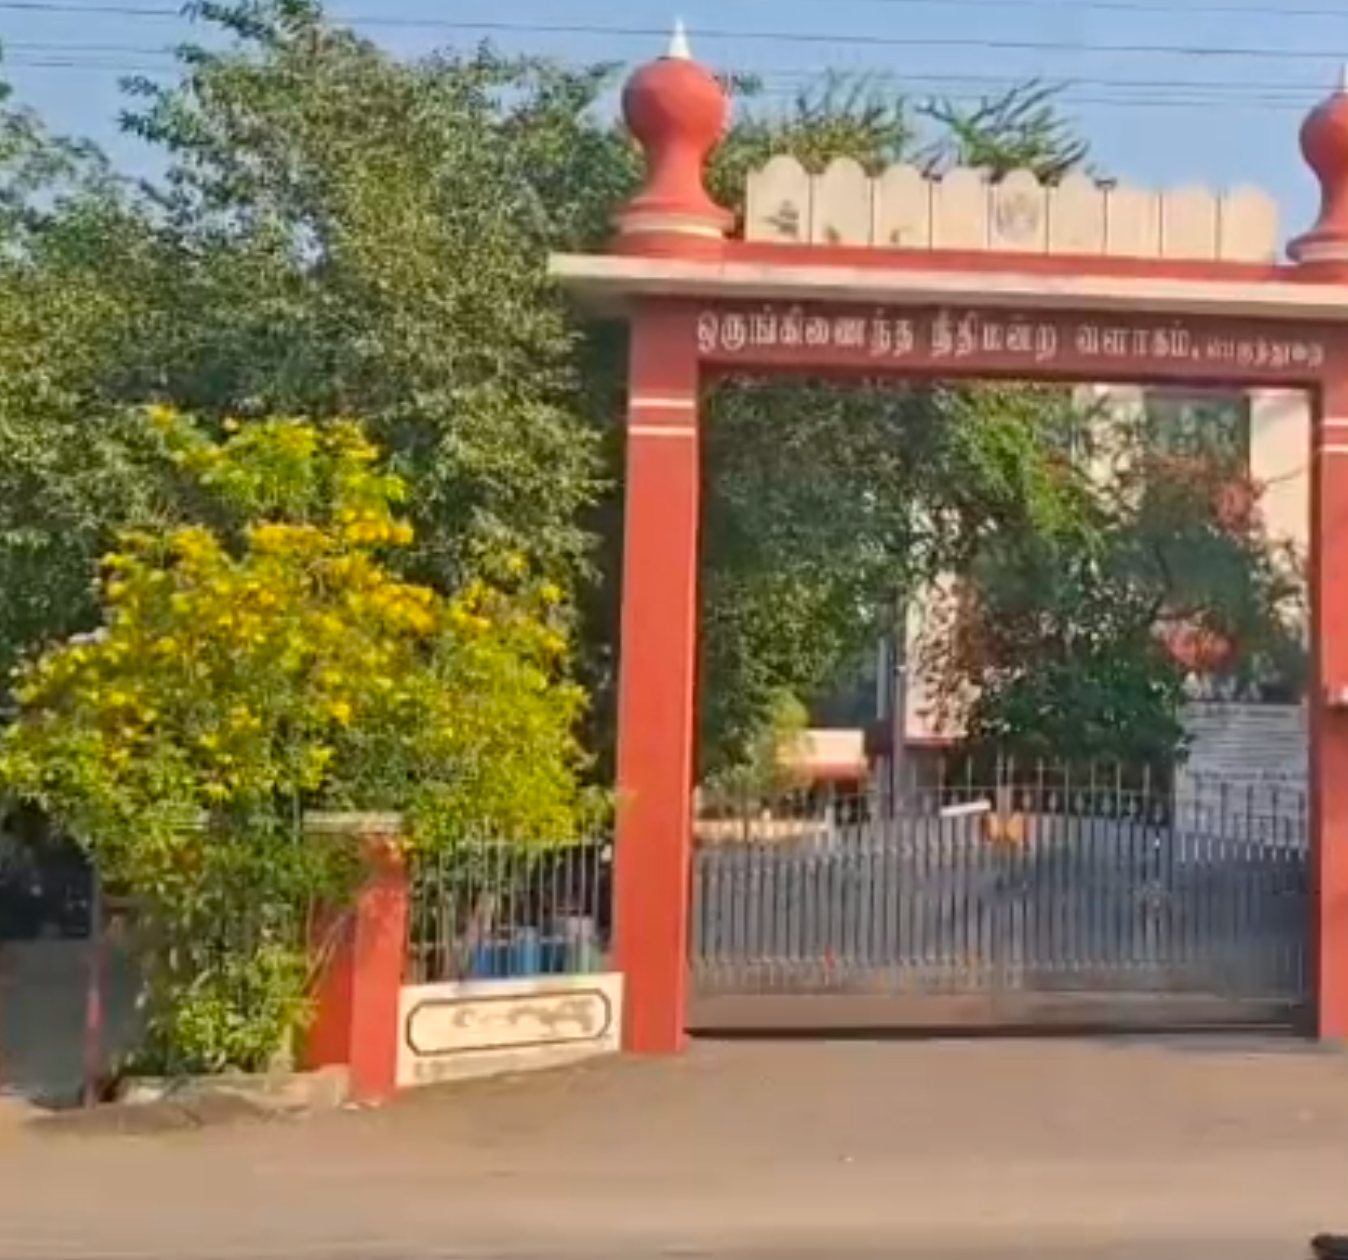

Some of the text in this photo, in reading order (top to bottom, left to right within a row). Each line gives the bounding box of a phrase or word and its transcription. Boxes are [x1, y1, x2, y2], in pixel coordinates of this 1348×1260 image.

[697, 303, 915, 356] ஒருங்கிணைந்த
[931, 308, 1058, 363] நீதிமன்ற
[1075, 320, 1200, 360] வளாகம்,
